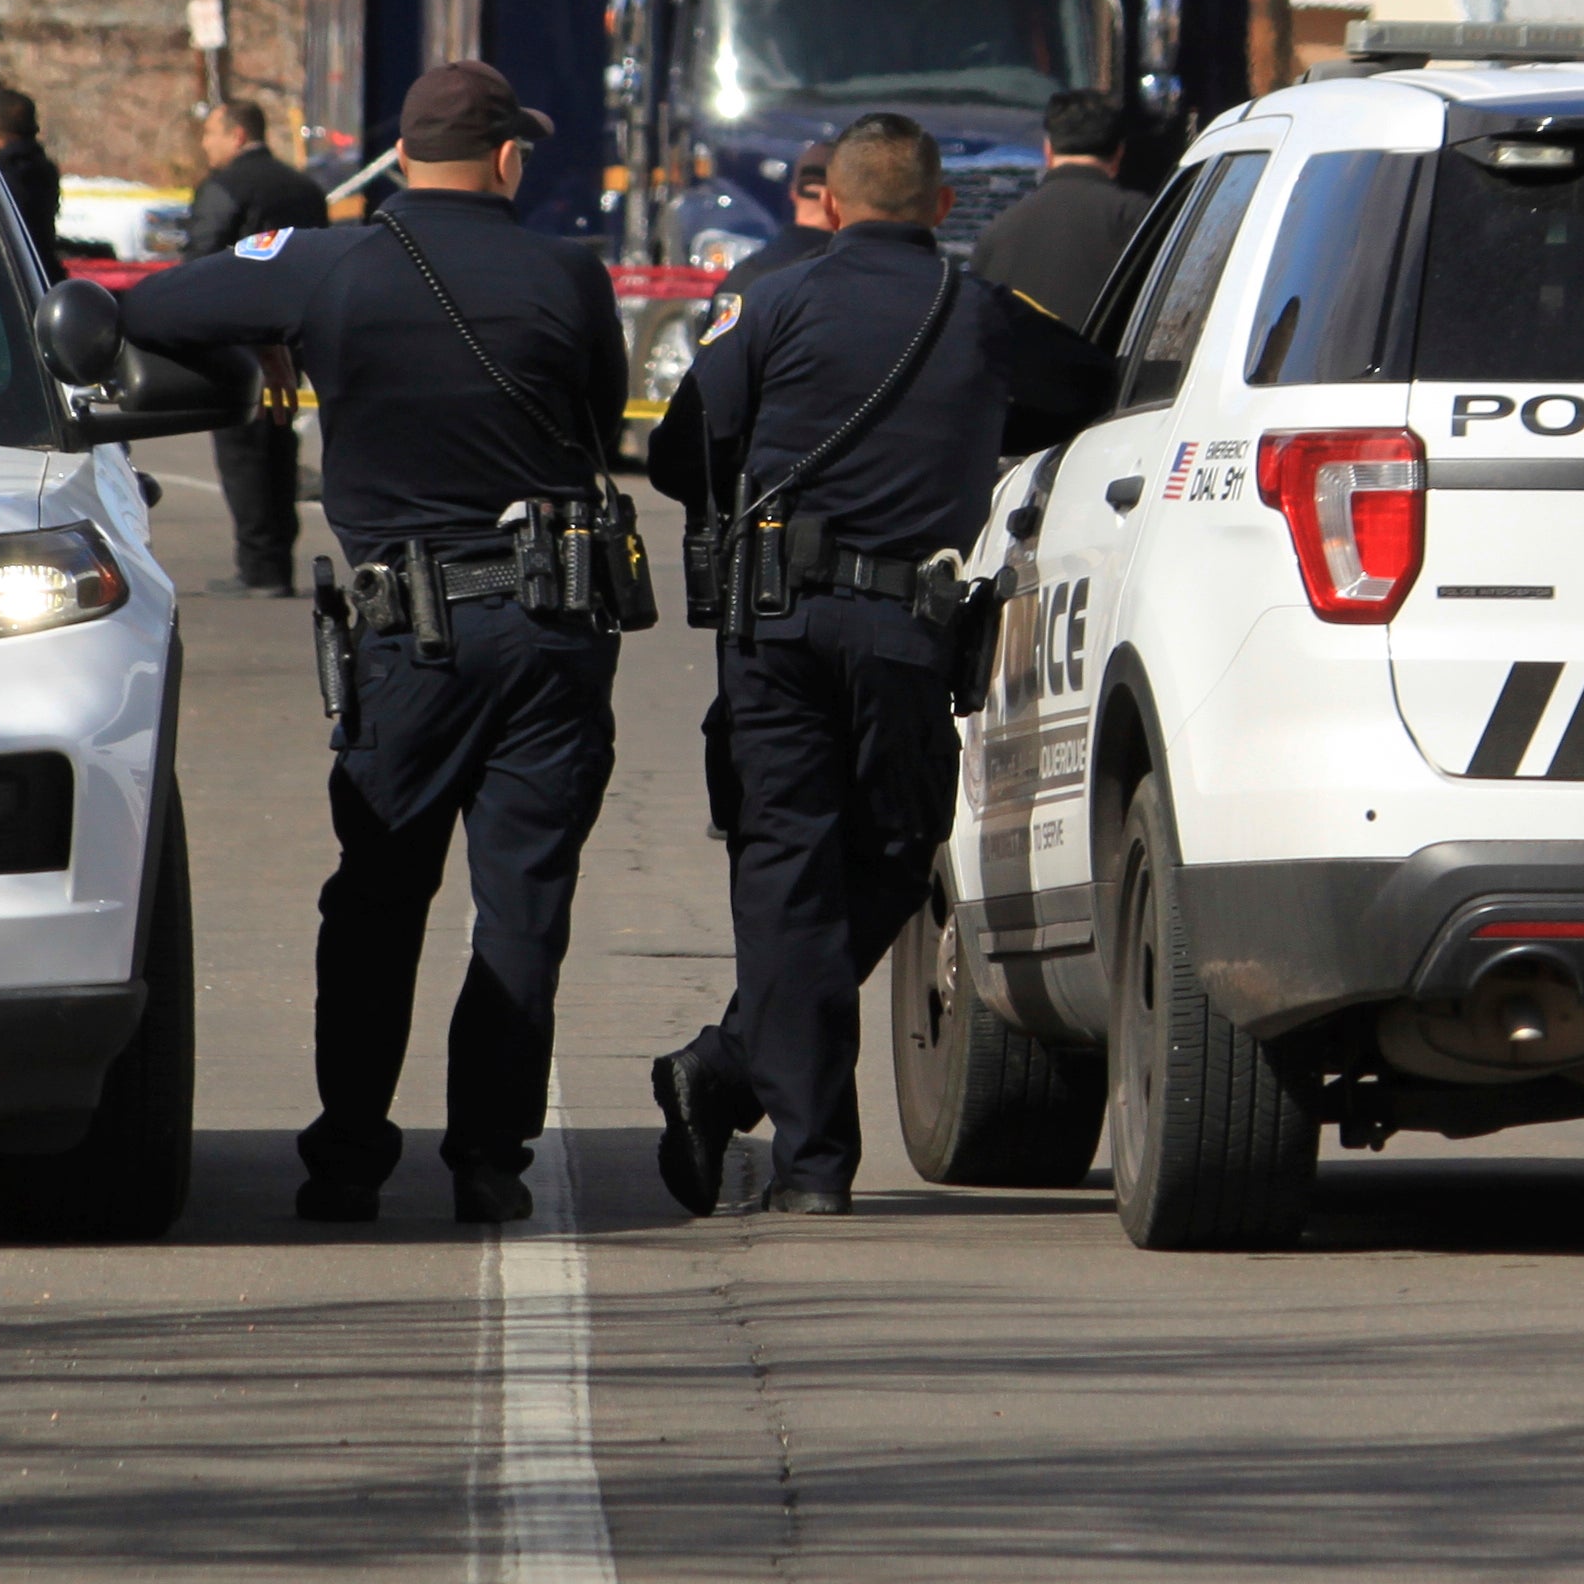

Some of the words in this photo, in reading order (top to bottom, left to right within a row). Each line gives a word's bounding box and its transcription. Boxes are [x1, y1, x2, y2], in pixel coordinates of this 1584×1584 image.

[1205, 440, 1252, 460] EMERGENCY
[1189, 466, 1220, 502] DIAL
[1220, 466, 1249, 501] 911
